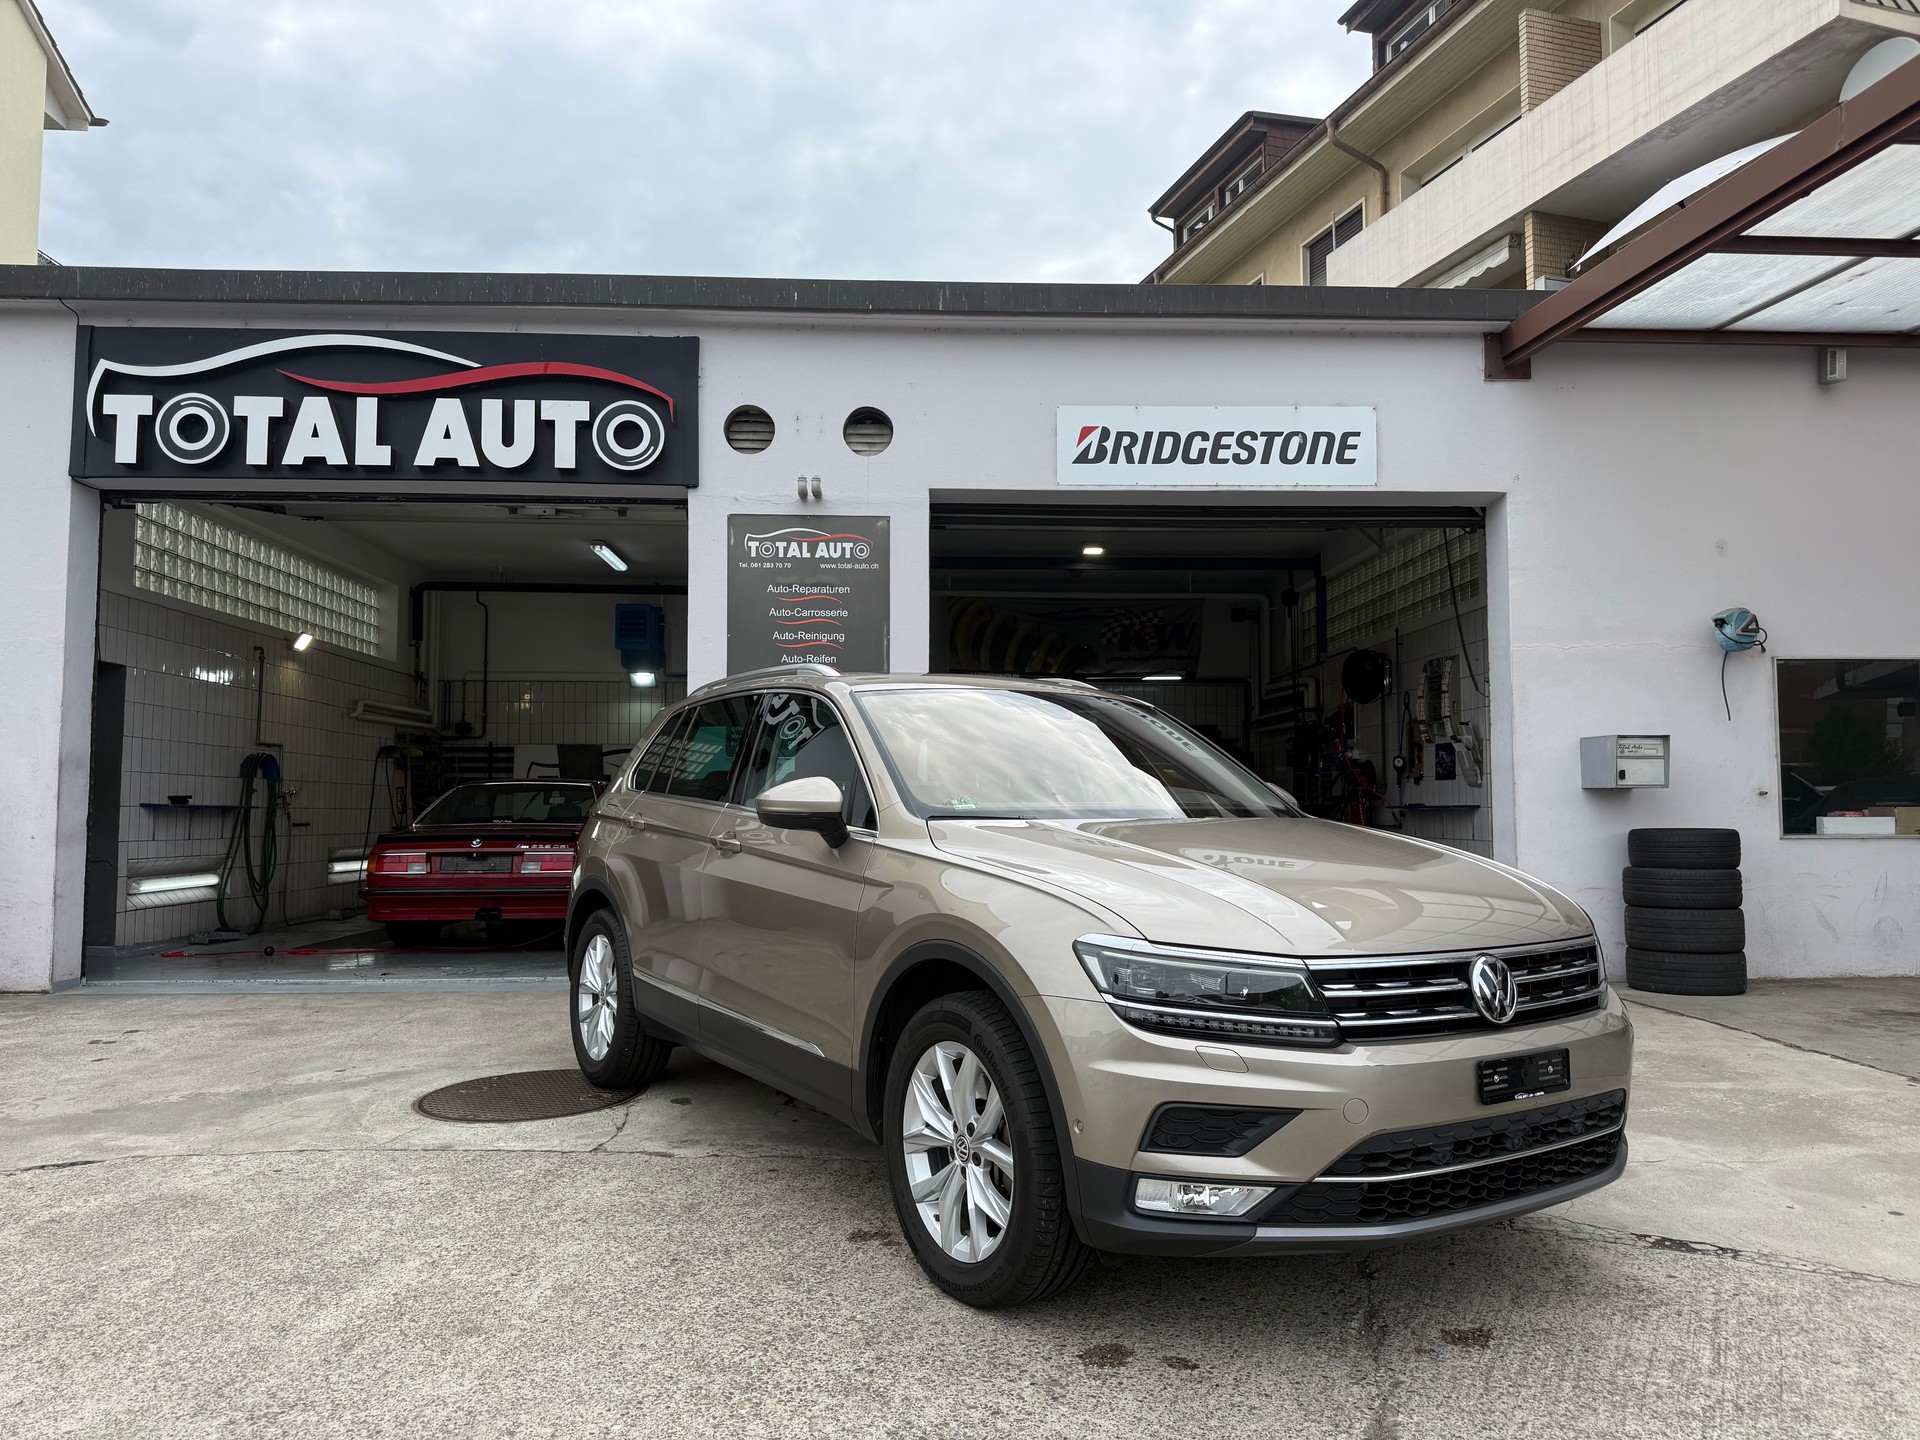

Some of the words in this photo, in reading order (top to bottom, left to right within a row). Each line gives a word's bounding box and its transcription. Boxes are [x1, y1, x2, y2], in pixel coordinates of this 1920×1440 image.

[103, 392, 392, 466] TOTAL
[413, 396, 665, 471] AUTO
[1071, 425, 1362, 465] BRIDGESTONE
[748, 541, 811, 558] TOTAL
[815, 541, 870, 559] AUTO
[767, 584, 850, 595] Auto-Reparaturen
[769, 607, 848, 617] Auto-Carrosserie
[772, 631, 845, 642] Auto-Reinigung
[781, 654, 837, 663] Auto-Reifen
[973, 1033, 1015, 1105] Continental
